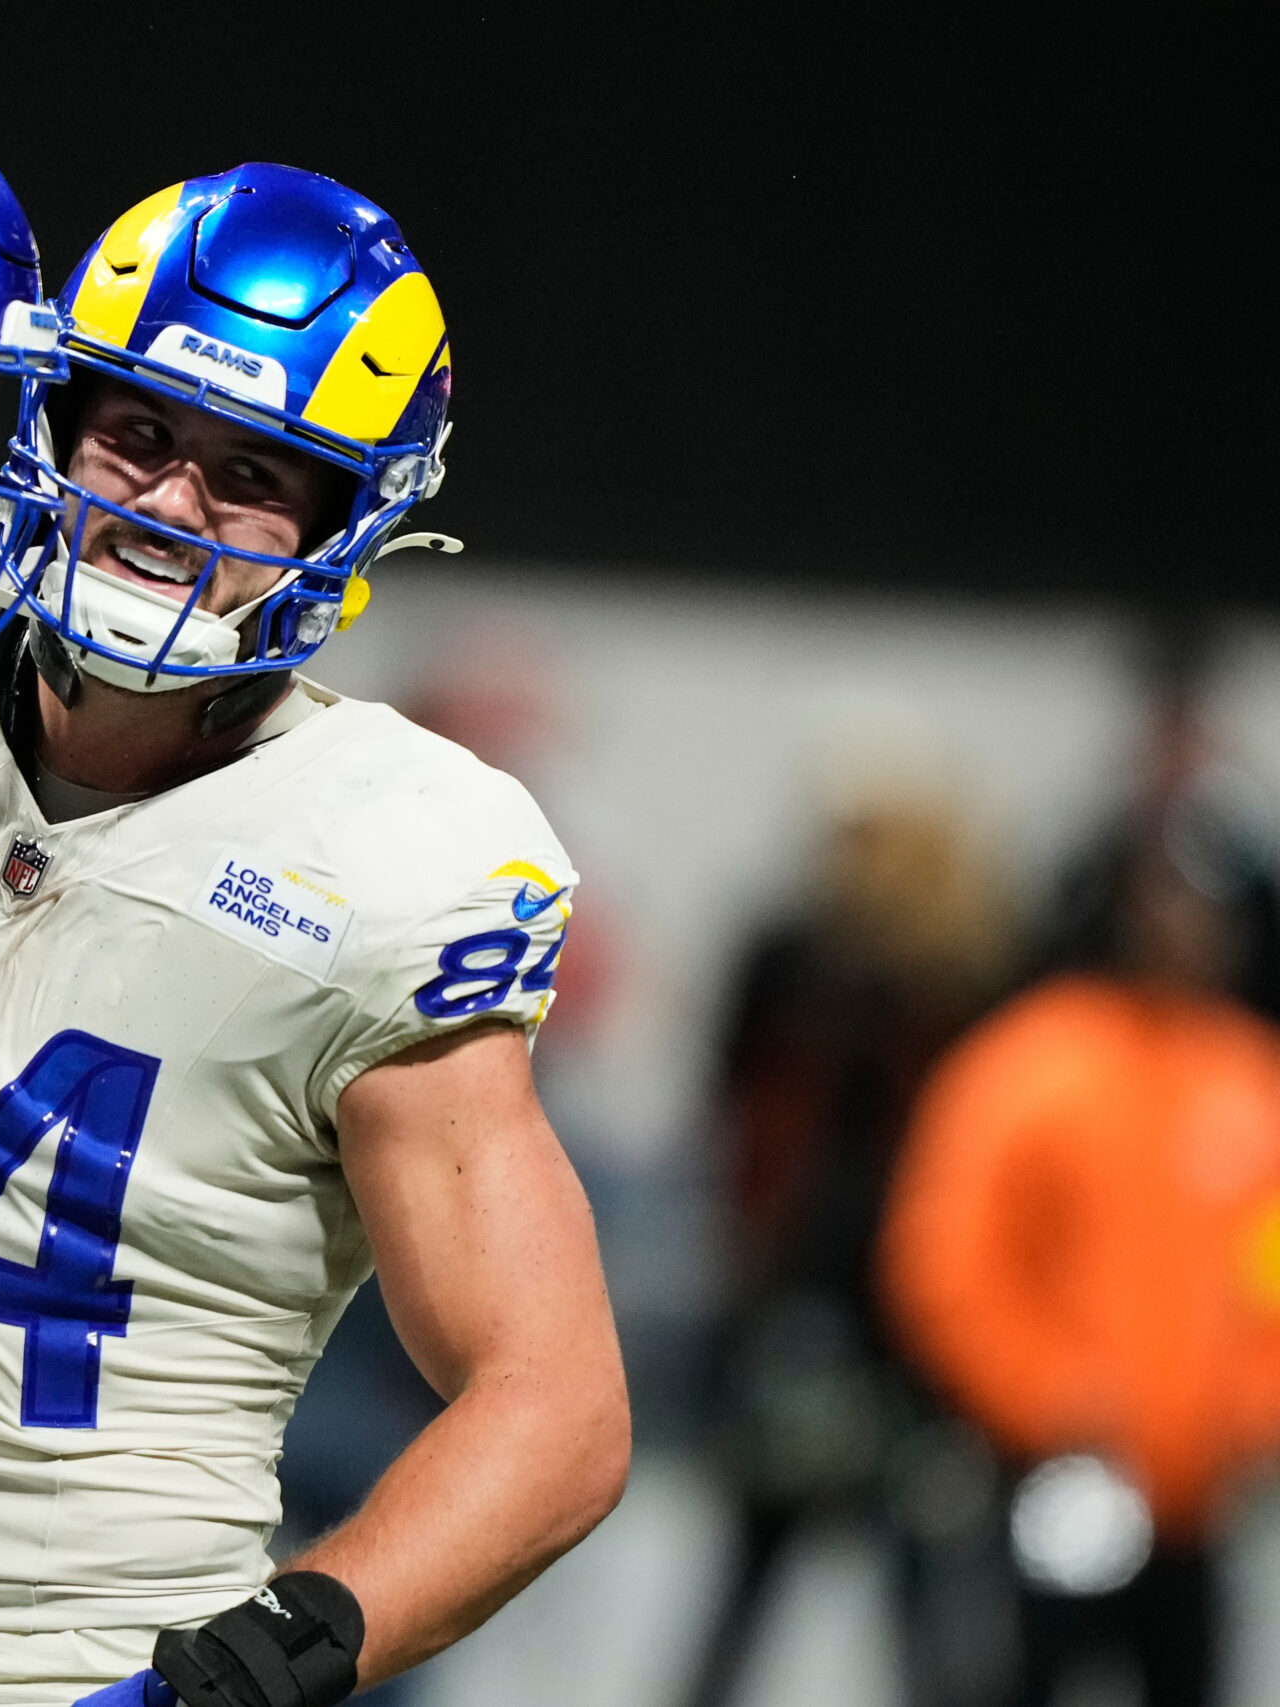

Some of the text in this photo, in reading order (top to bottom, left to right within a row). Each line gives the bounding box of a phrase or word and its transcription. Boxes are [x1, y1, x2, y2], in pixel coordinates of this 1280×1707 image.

[181, 334, 263, 378] RAMS
[7, 858, 36, 890] NFL
[225, 860, 274, 894] LOS
[209, 891, 281, 937] RAMS
[216, 878, 331, 943] ANGELES
